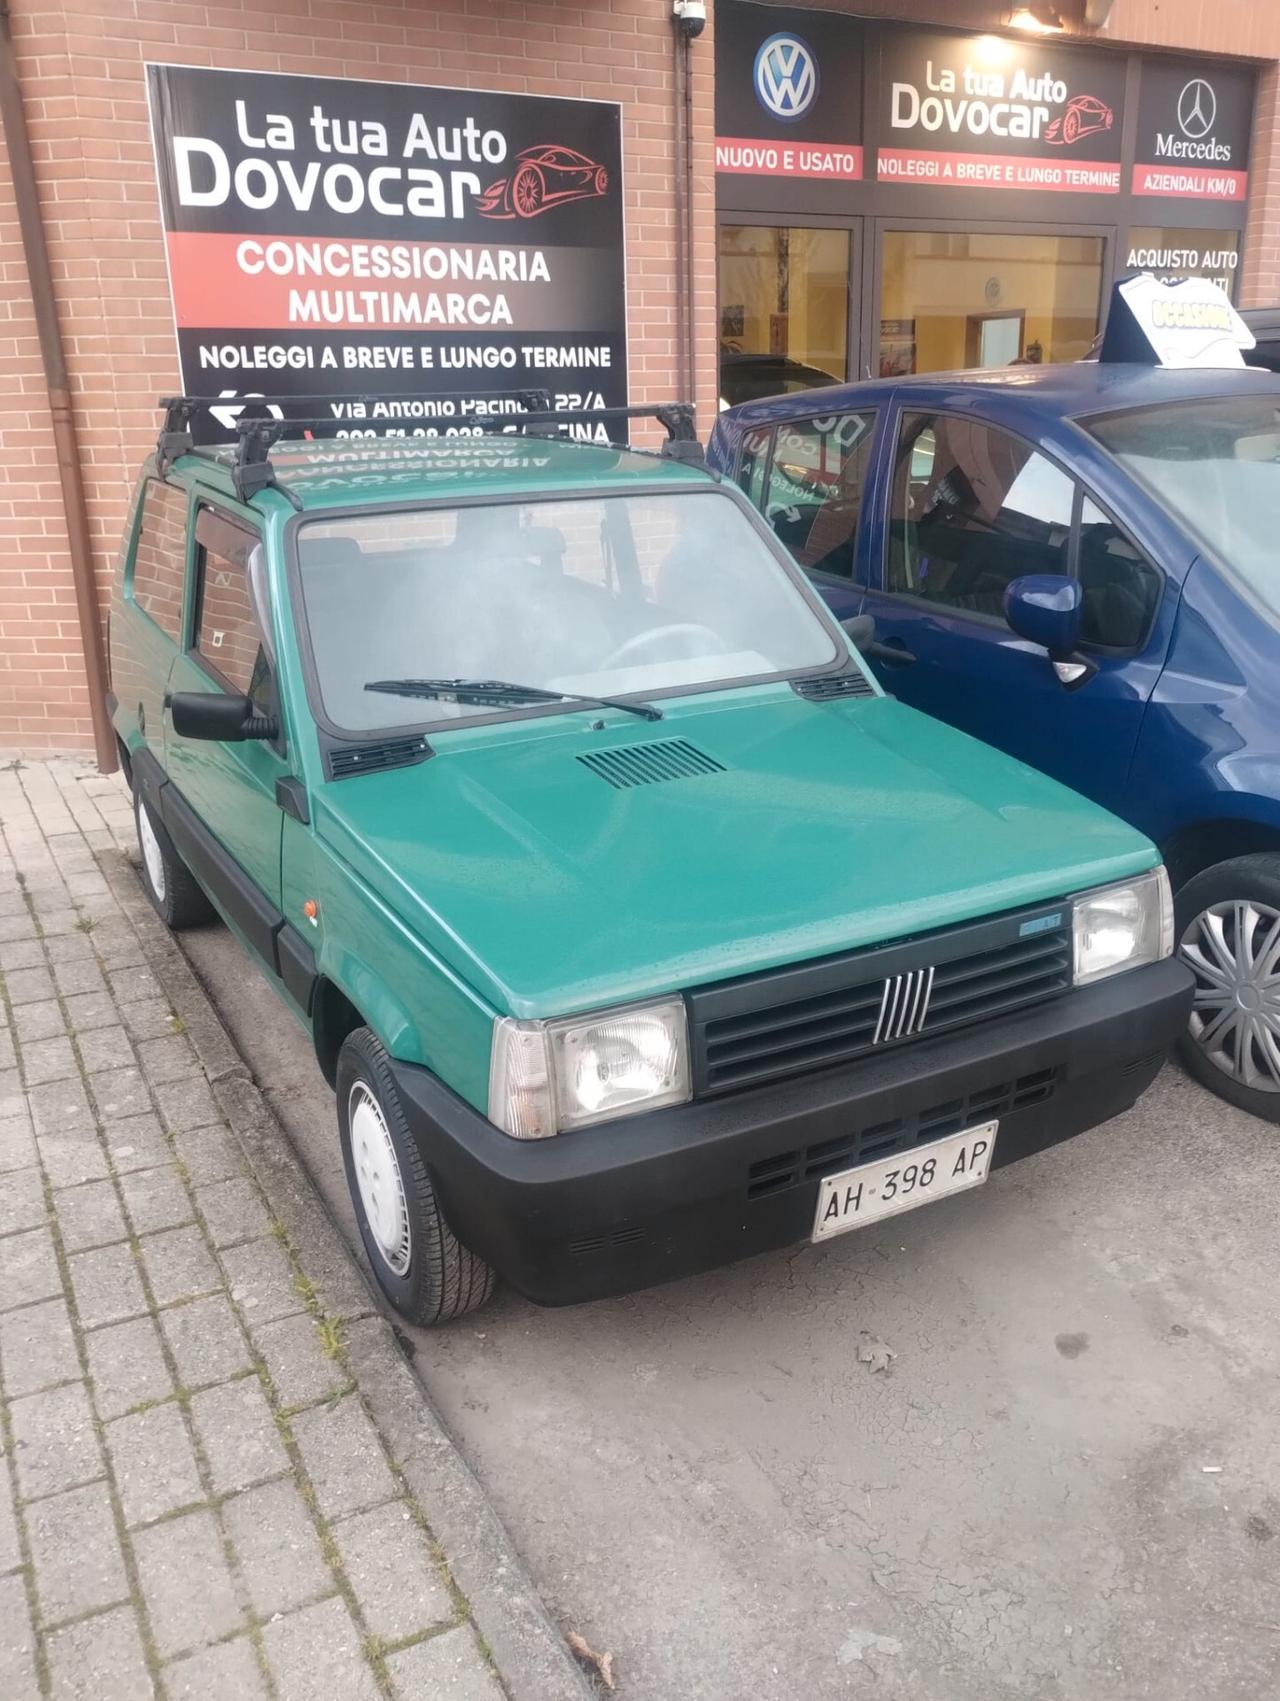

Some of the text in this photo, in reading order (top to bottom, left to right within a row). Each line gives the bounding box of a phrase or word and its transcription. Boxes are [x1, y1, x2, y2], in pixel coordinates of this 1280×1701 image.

[925, 60, 1067, 104] La tua Auto
[891, 82, 1049, 139] Dovocar
[235, 100, 507, 164] La tua Auto
[1155, 133, 1231, 161] Mercedes
[716, 146, 854, 173] NUOVO E USATO
[877, 157, 1120, 187] NOLEGGI A BREVE E LUNGO TERMINE
[173, 136, 481, 219] Dovocar
[1144, 173, 1237, 197] AZIENDALI KM/0
[236, 240, 551, 282] CONCESSIONARIA
[1126, 248, 1238, 269] ACQUISTO AUTO
[289, 289, 513, 325] MULTIMARCA
[199, 345, 611, 369] NOLEGGI A BREVE E LUNGO TERMINE
[554, 391, 606, 411] 22/A
[824, 1140, 988, 1222] AH 398 AP
